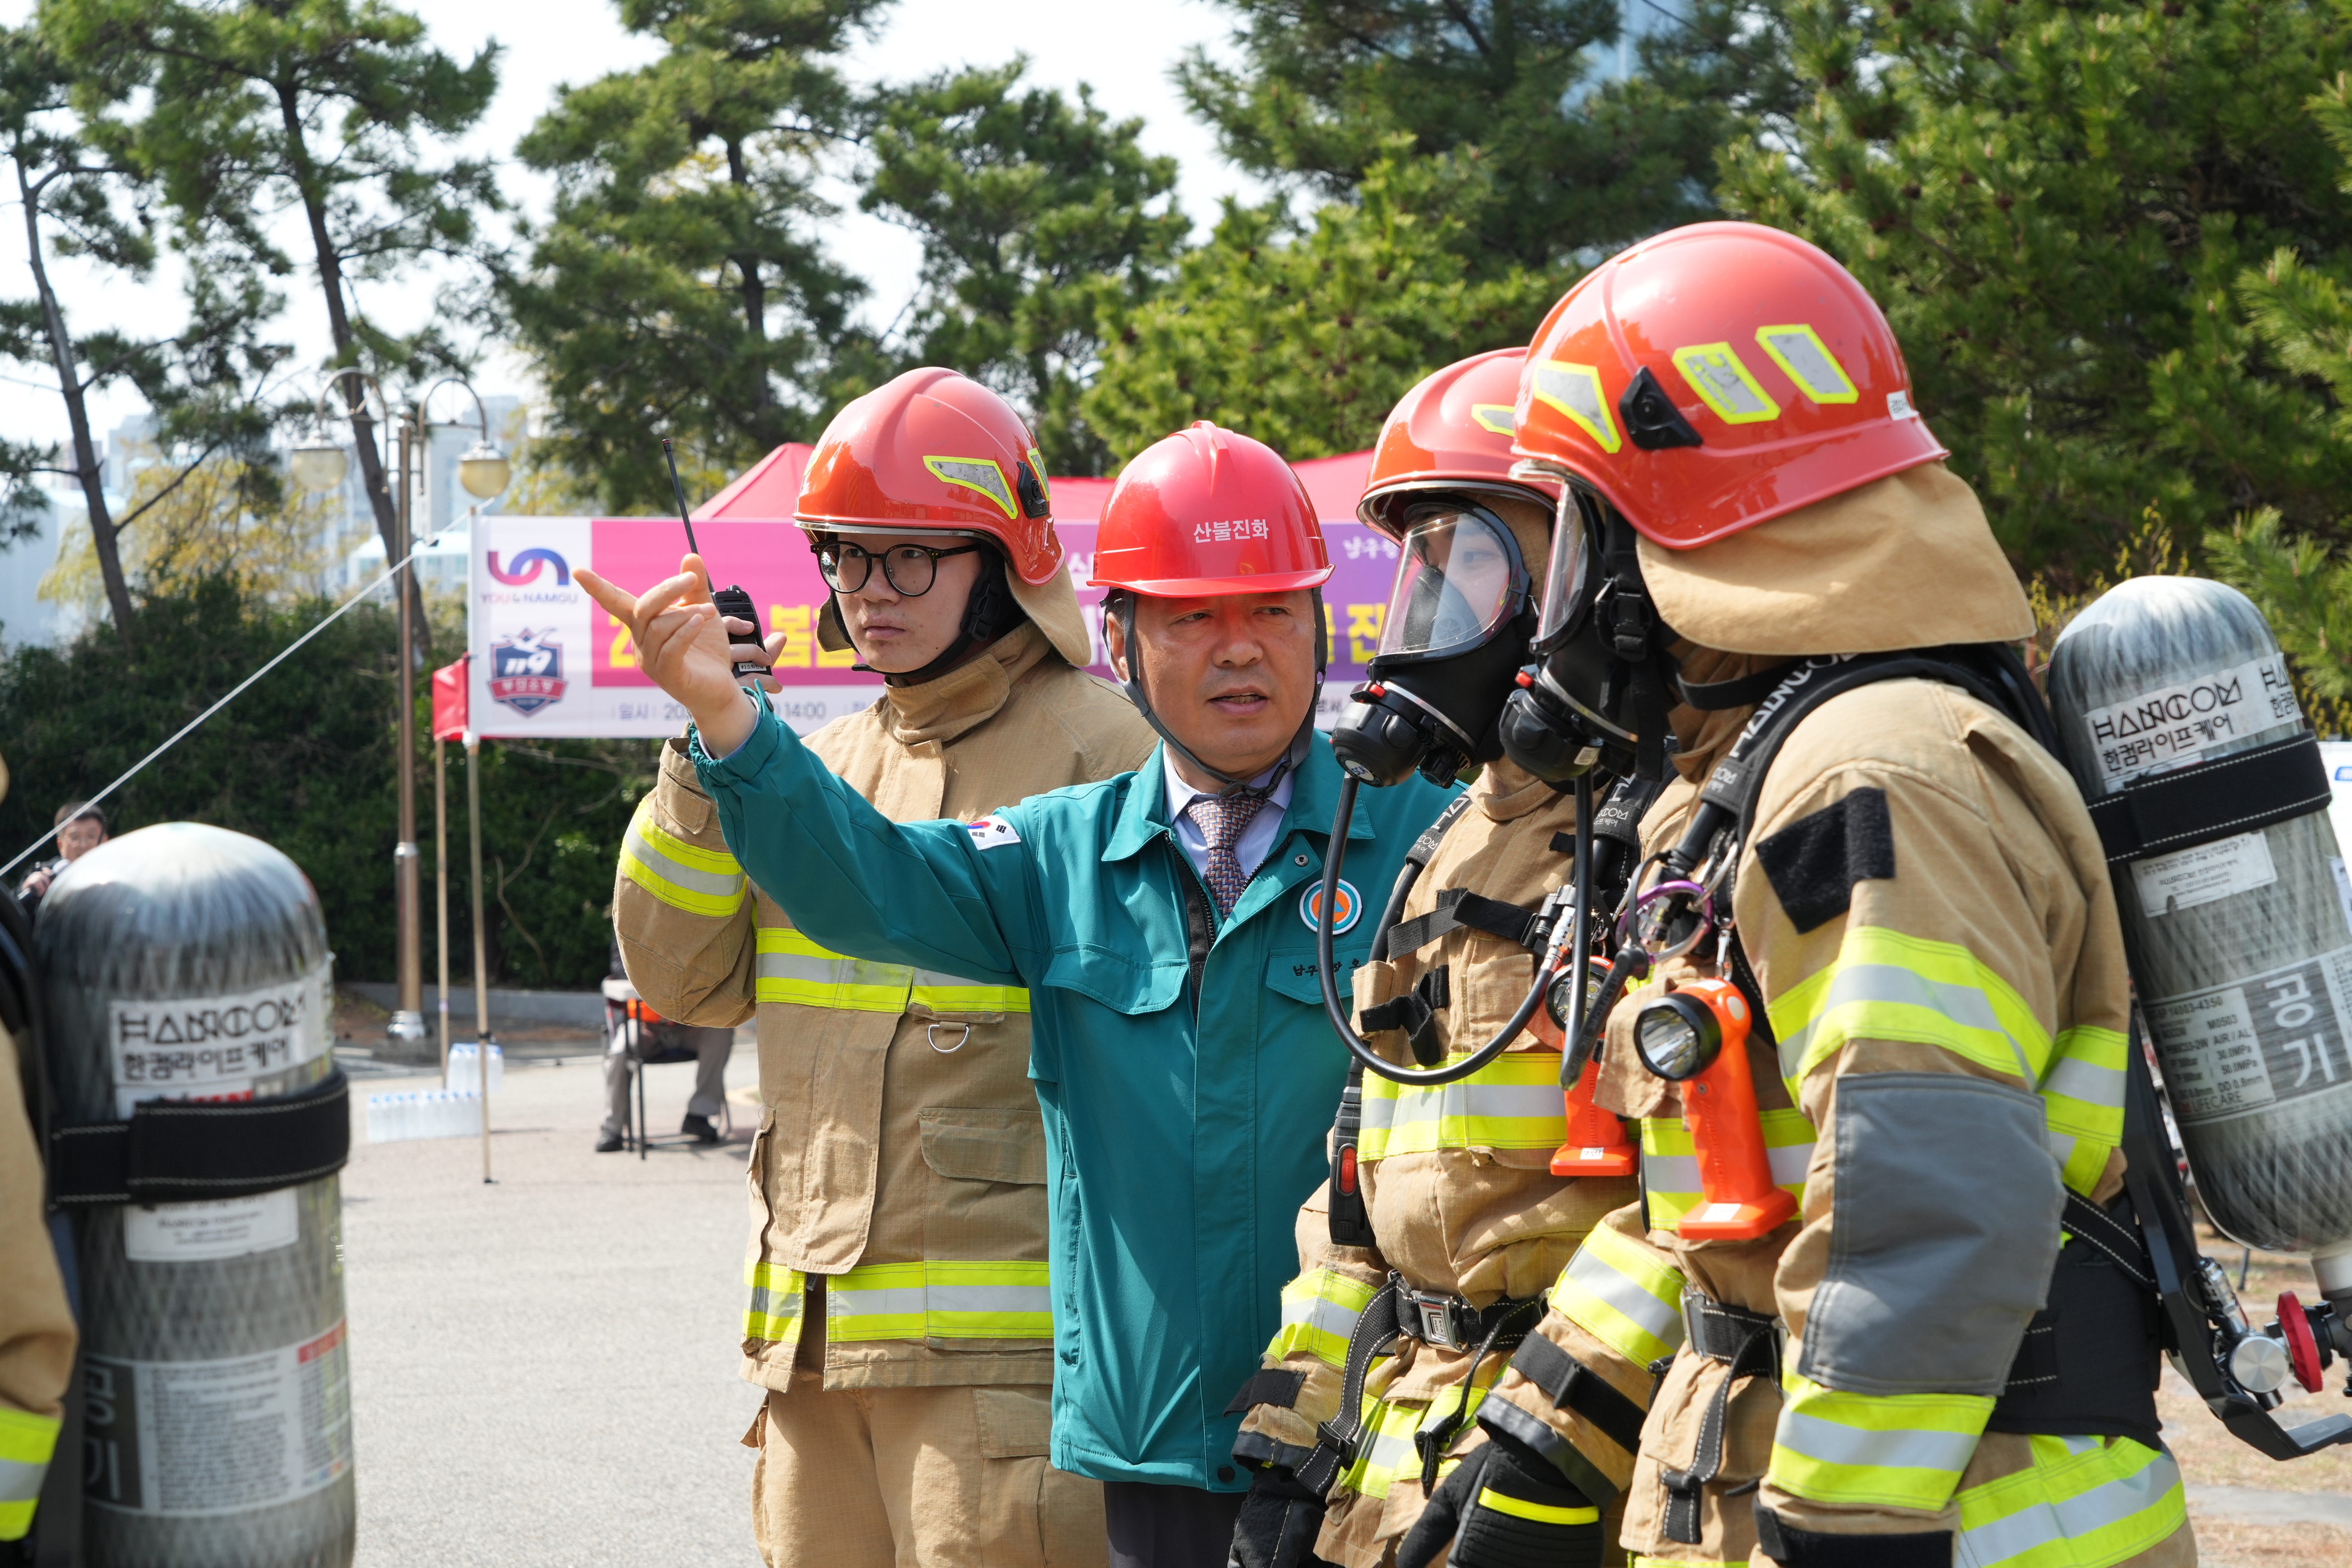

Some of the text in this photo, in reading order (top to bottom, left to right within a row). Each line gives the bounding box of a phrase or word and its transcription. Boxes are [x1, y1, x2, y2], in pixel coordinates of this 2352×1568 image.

[1193, 519, 1269, 543] 산불진화
[503, 649, 552, 676] 119
[620, 701, 649, 722] 일시
[664, 702, 691, 721] 20
[784, 701, 827, 721] 14:00
[2093, 676, 2243, 744] HANCOM
[2102, 714, 2234, 772] 한컴라이프케어
[1351, 765, 1369, 777] SCA
[1542, 901, 1551, 914] SCA
[1293, 961, 1343, 977] 남구장
[120, 996, 305, 1044] HANCOM
[2264, 972, 2336, 1088] 공기
[124, 1035, 289, 1081] 한컴라이프케어
